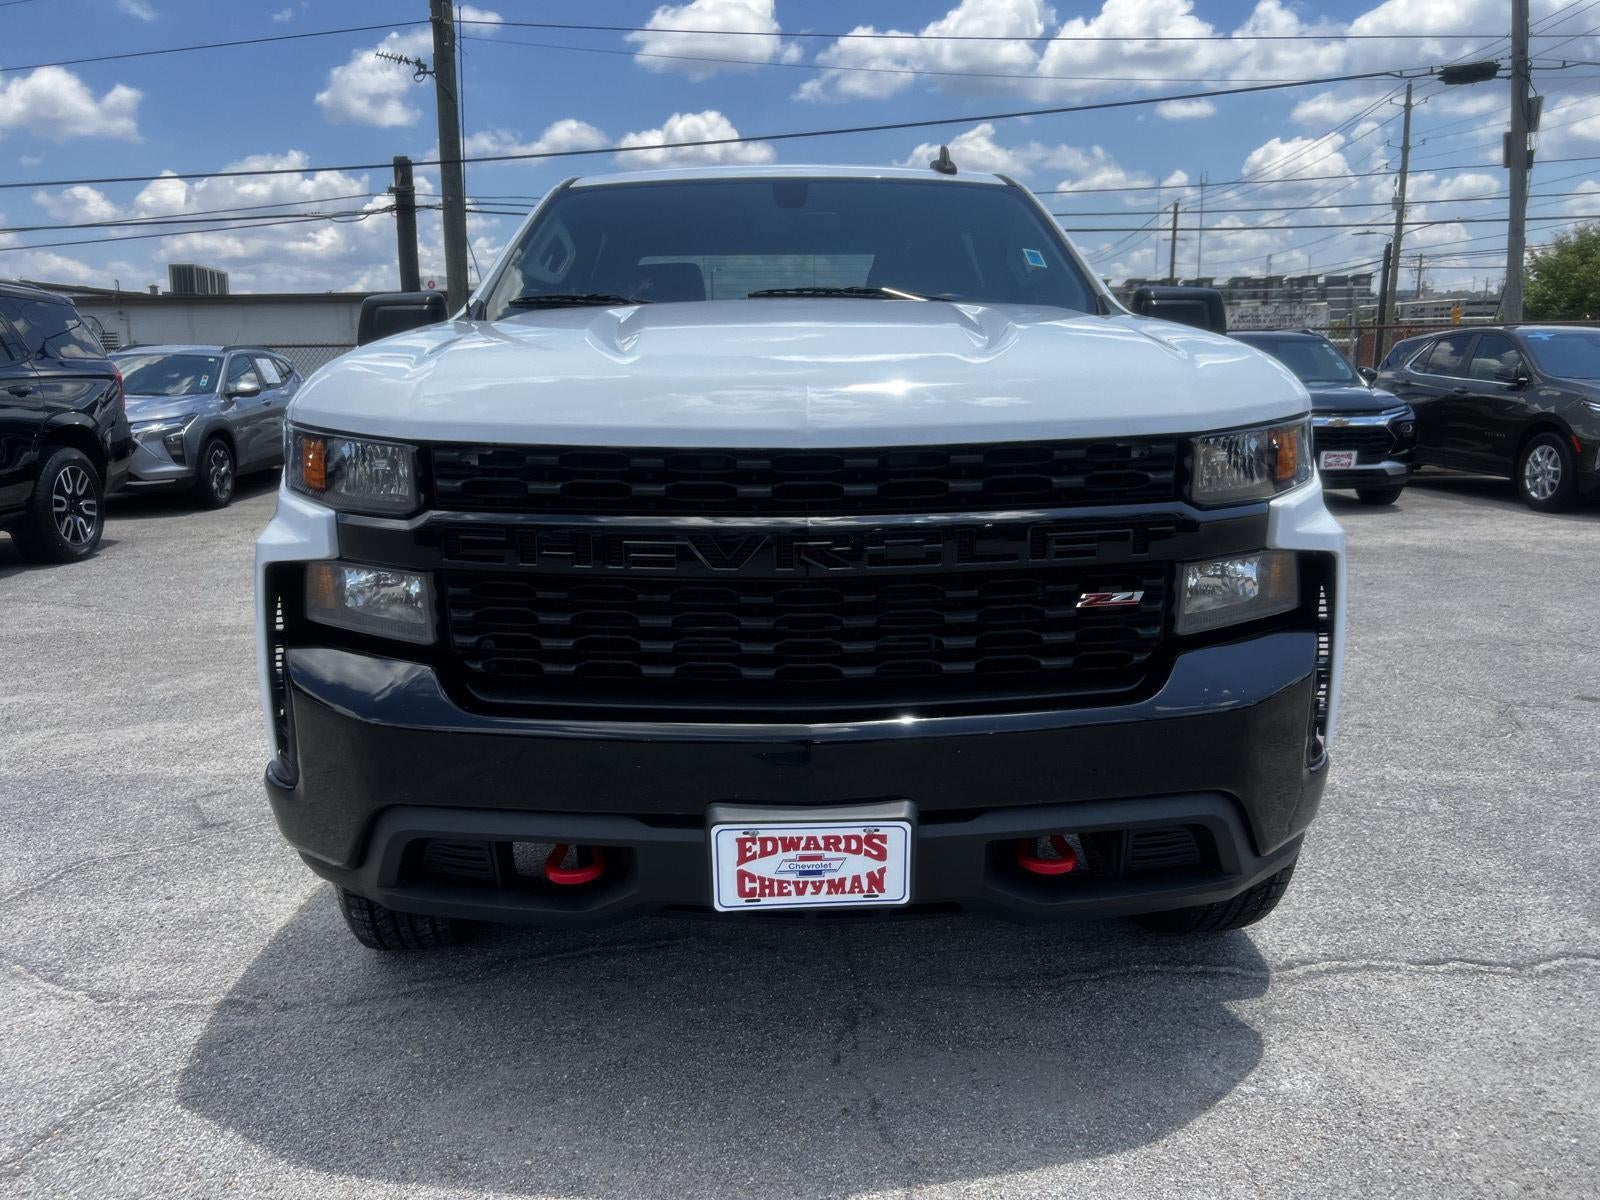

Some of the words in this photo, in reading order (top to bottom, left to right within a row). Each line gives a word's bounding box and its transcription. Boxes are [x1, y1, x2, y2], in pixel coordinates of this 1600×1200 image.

[443, 525, 1176, 570] CHEVROLET
[1076, 591, 1145, 608] Z71
[736, 834, 888, 867] EDWARDS
[788, 861, 832, 870] Chevrolet
[736, 866, 887, 898] CHEVYMAN
